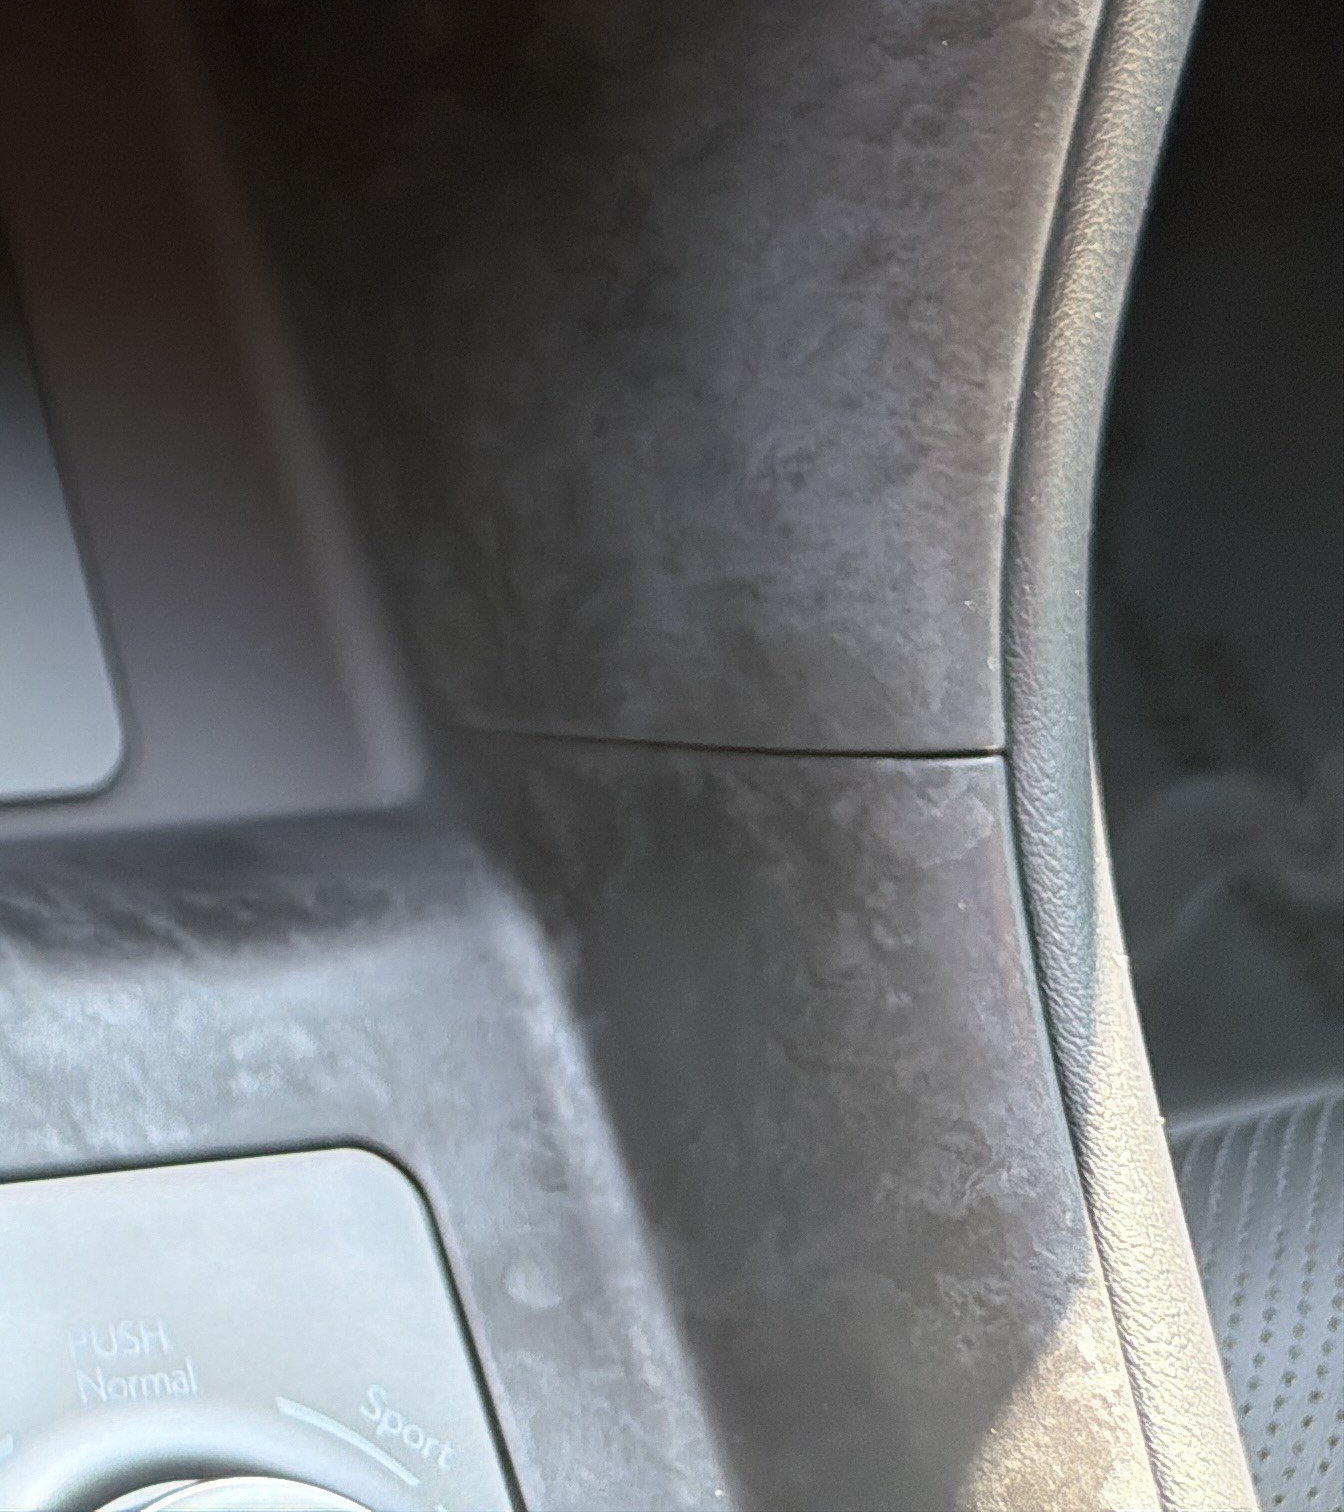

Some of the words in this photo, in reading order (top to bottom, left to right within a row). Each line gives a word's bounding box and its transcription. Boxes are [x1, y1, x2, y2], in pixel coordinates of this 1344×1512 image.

[68, 1317, 173, 1362] PUSH
[75, 1355, 200, 1404] Normal
[357, 1382, 457, 1473] Sport
